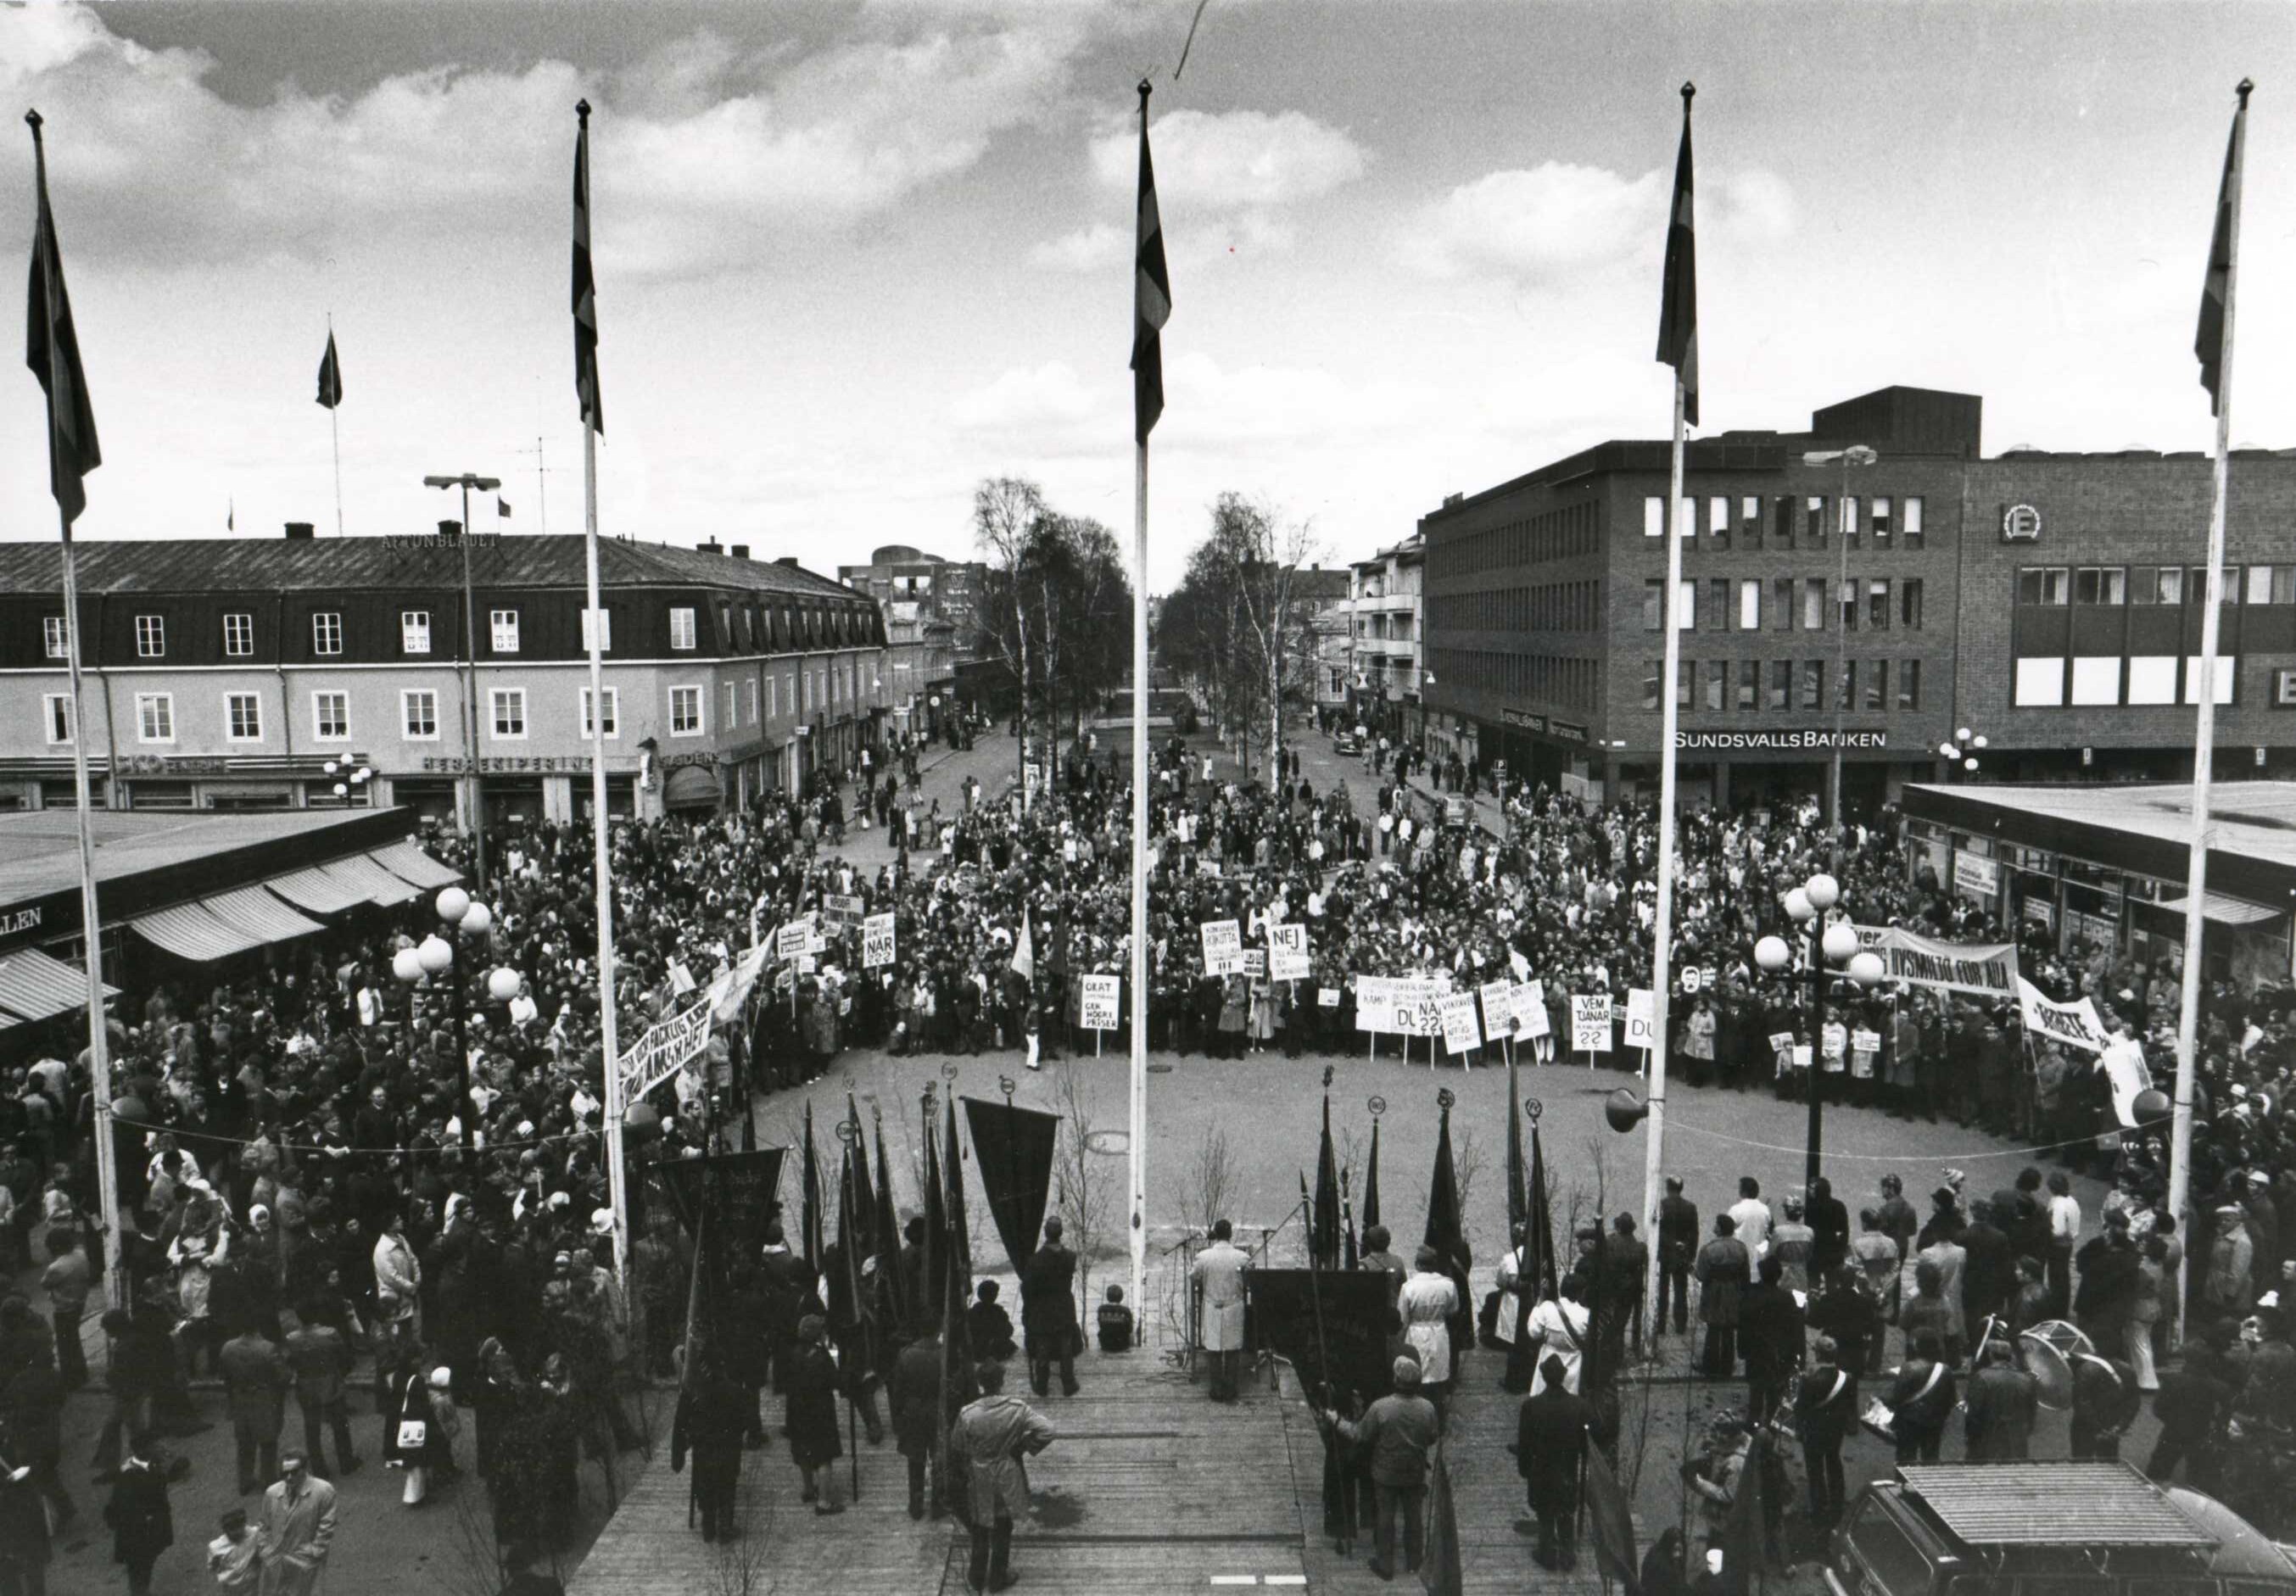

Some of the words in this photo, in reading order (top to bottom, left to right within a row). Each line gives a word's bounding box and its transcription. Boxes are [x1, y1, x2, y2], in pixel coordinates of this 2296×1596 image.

[1273, 928, 1299, 951] NEJ
[1581, 998, 1605, 1009] VEM
[650, 1016, 688, 1048] FACKLIG
